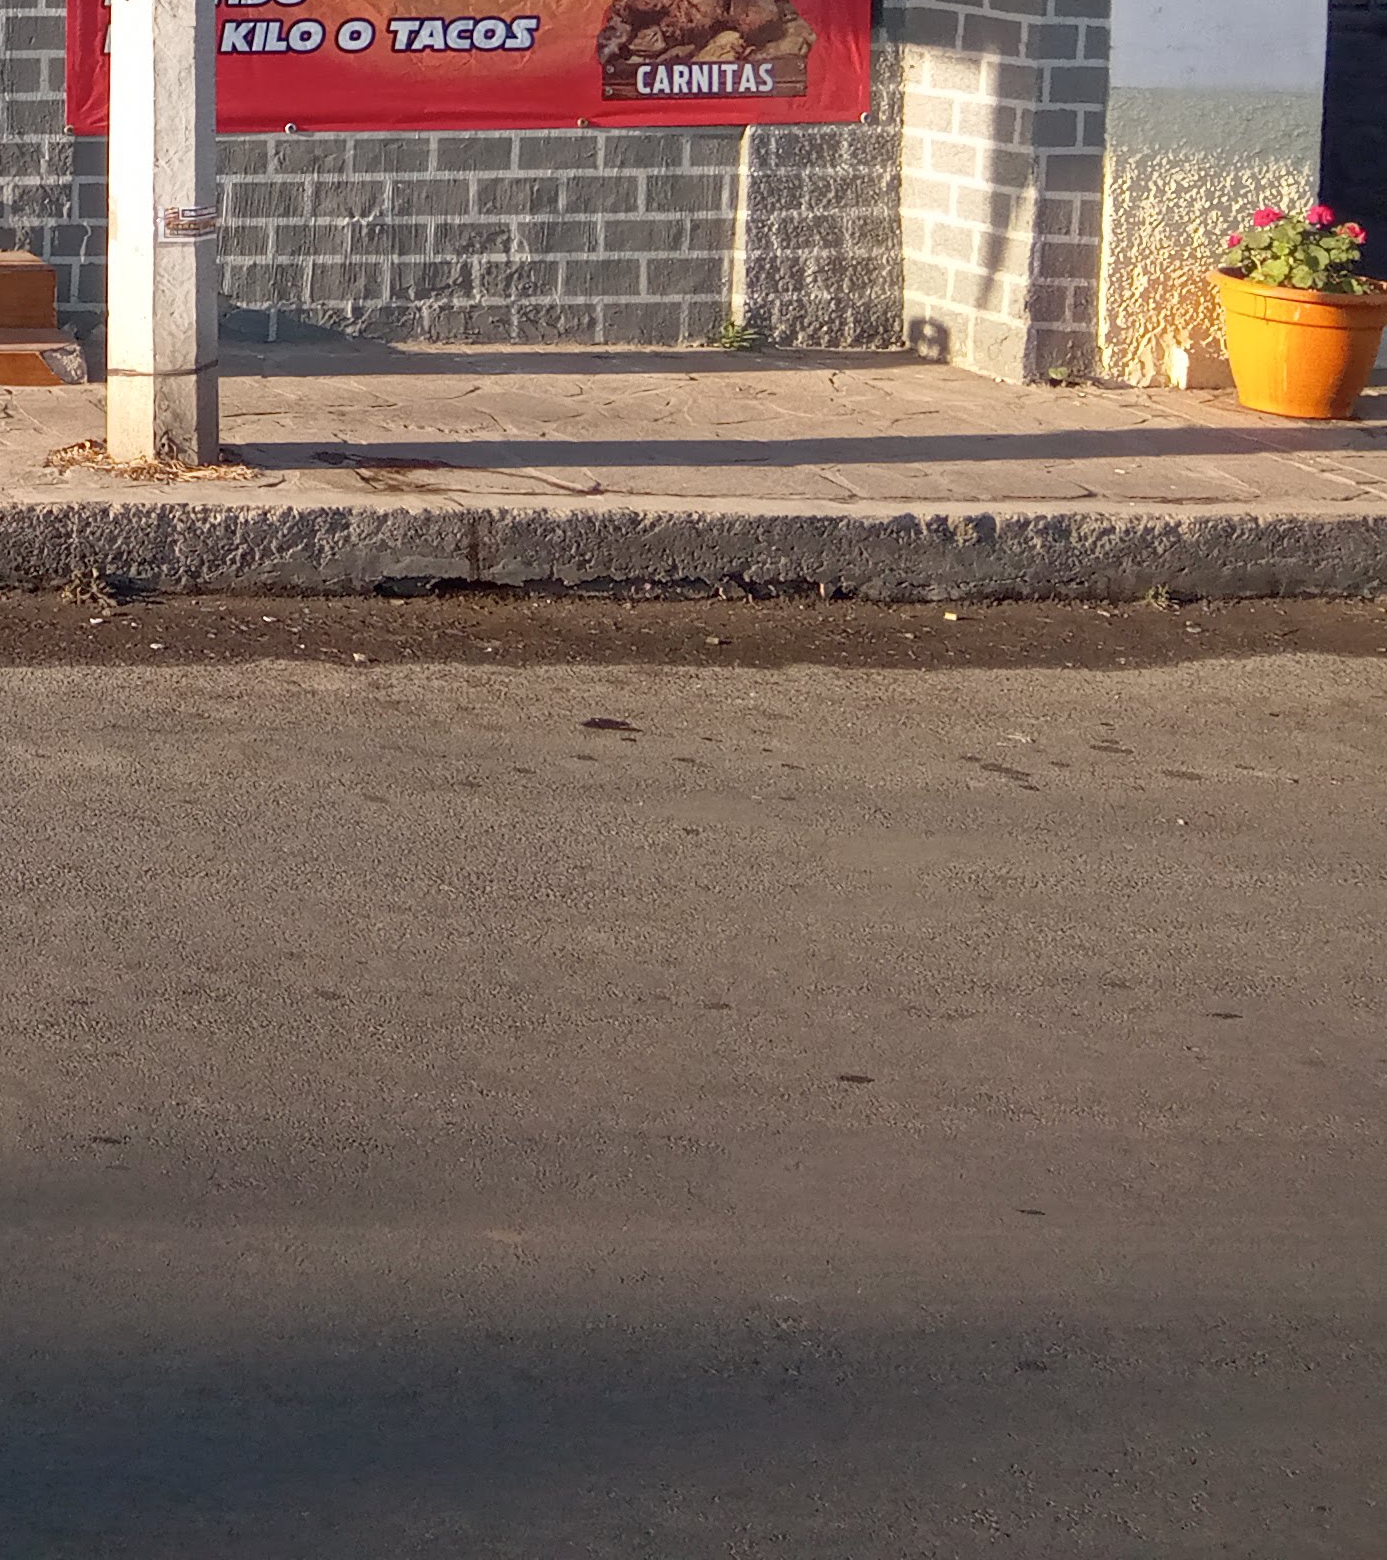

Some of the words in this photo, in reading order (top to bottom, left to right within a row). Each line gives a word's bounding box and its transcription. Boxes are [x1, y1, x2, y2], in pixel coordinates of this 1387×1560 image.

[218, 17, 326, 55] KILO
[335, 17, 376, 54] O
[388, 15, 541, 54] TACOS
[636, 62, 774, 94] CARNITAS
